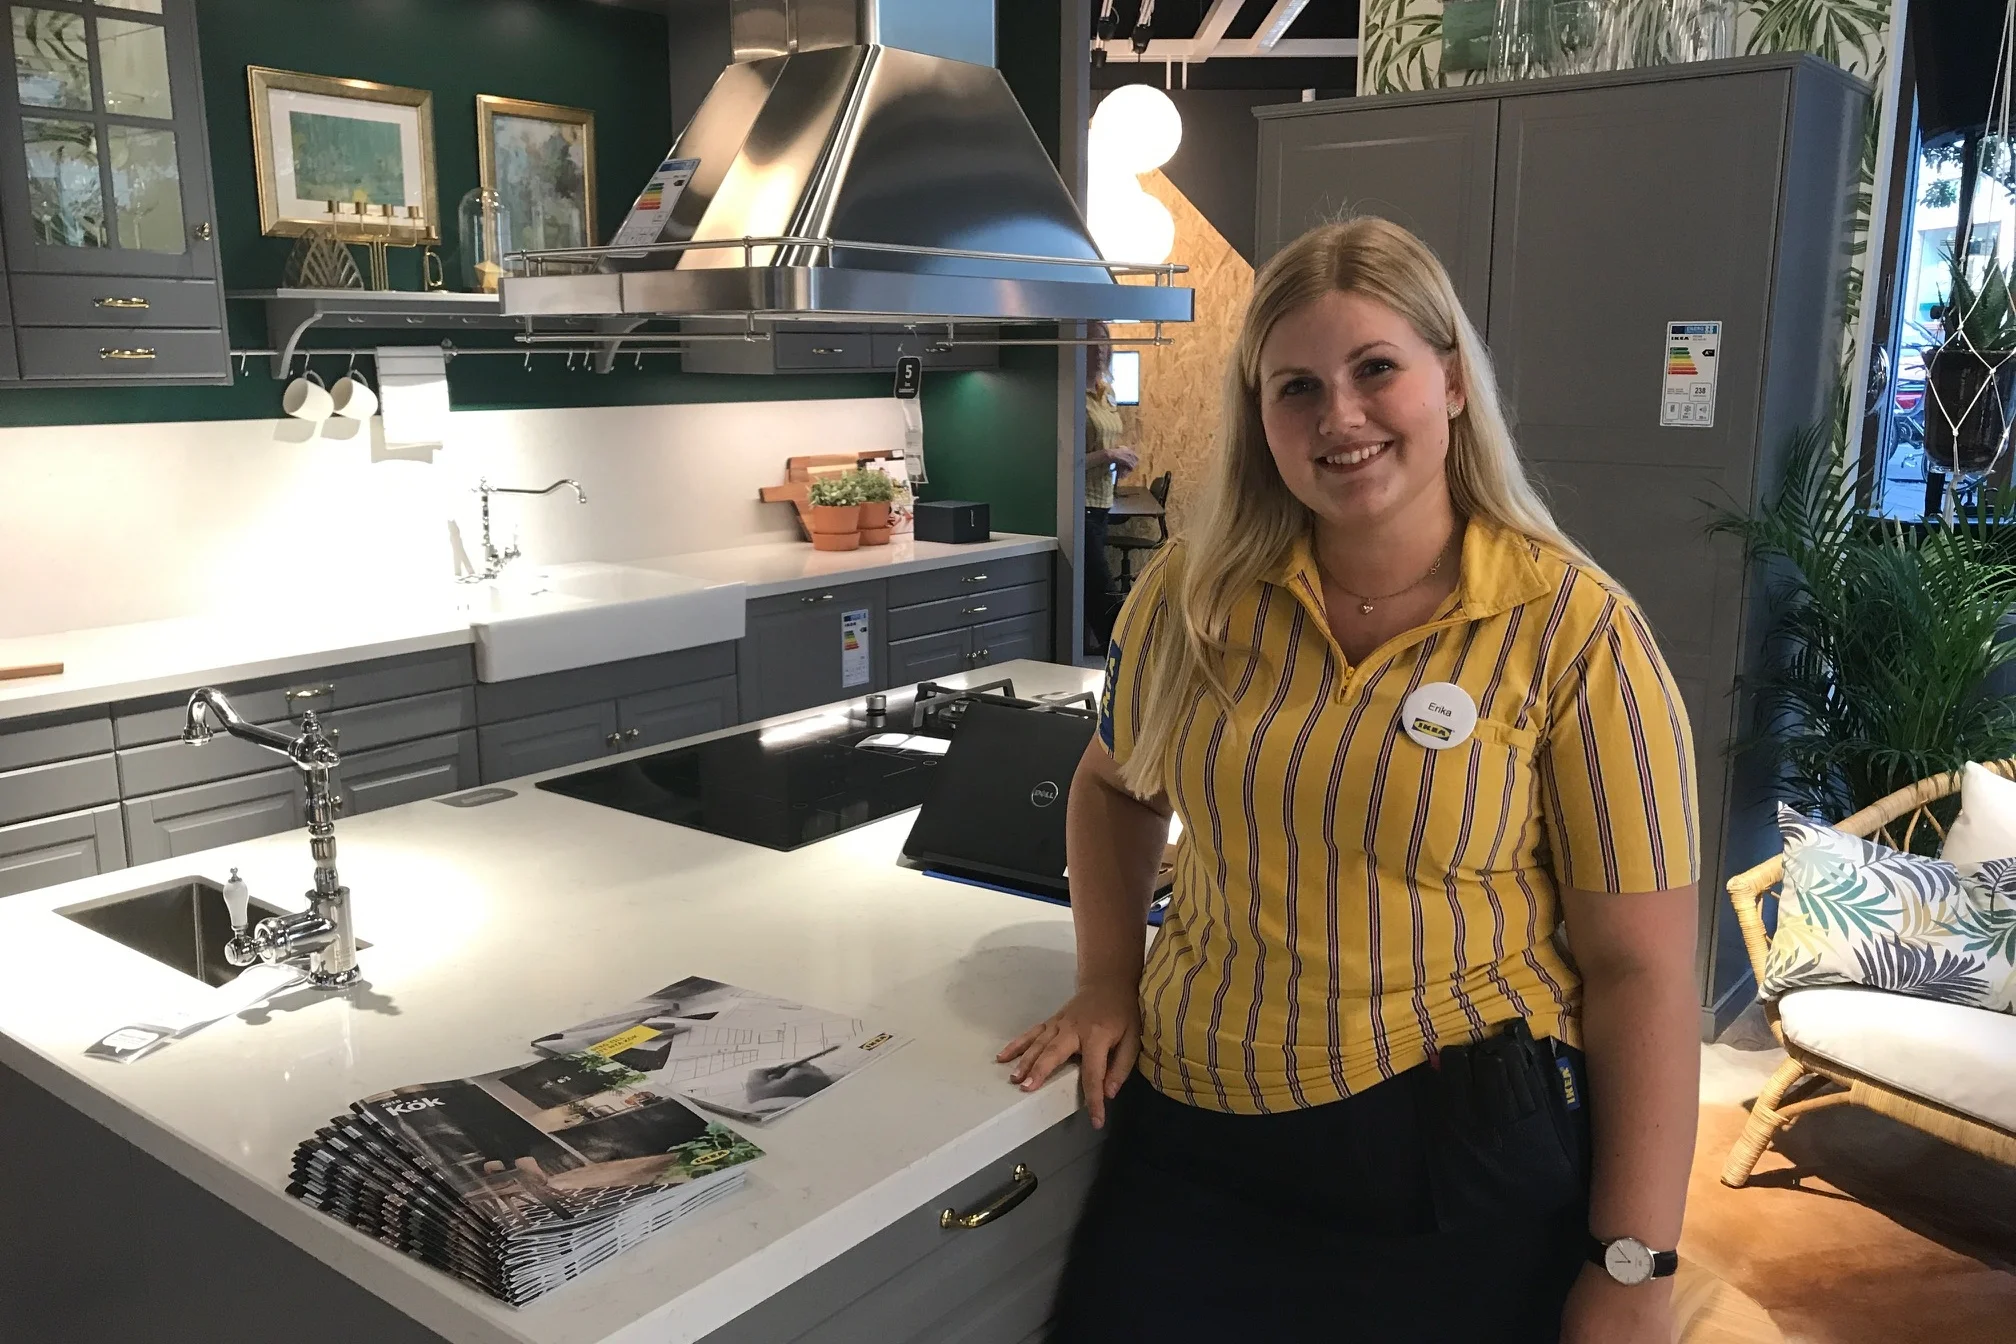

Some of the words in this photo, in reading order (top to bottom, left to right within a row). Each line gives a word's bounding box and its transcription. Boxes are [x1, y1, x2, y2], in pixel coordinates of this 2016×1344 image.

[905, 364, 913, 379] 5
[1427, 701, 1453, 718] Erika
[1418, 722, 1446, 737] IKEA
[380, 1099, 402, 1108] 2018
[385, 1097, 446, 1117] Kök
